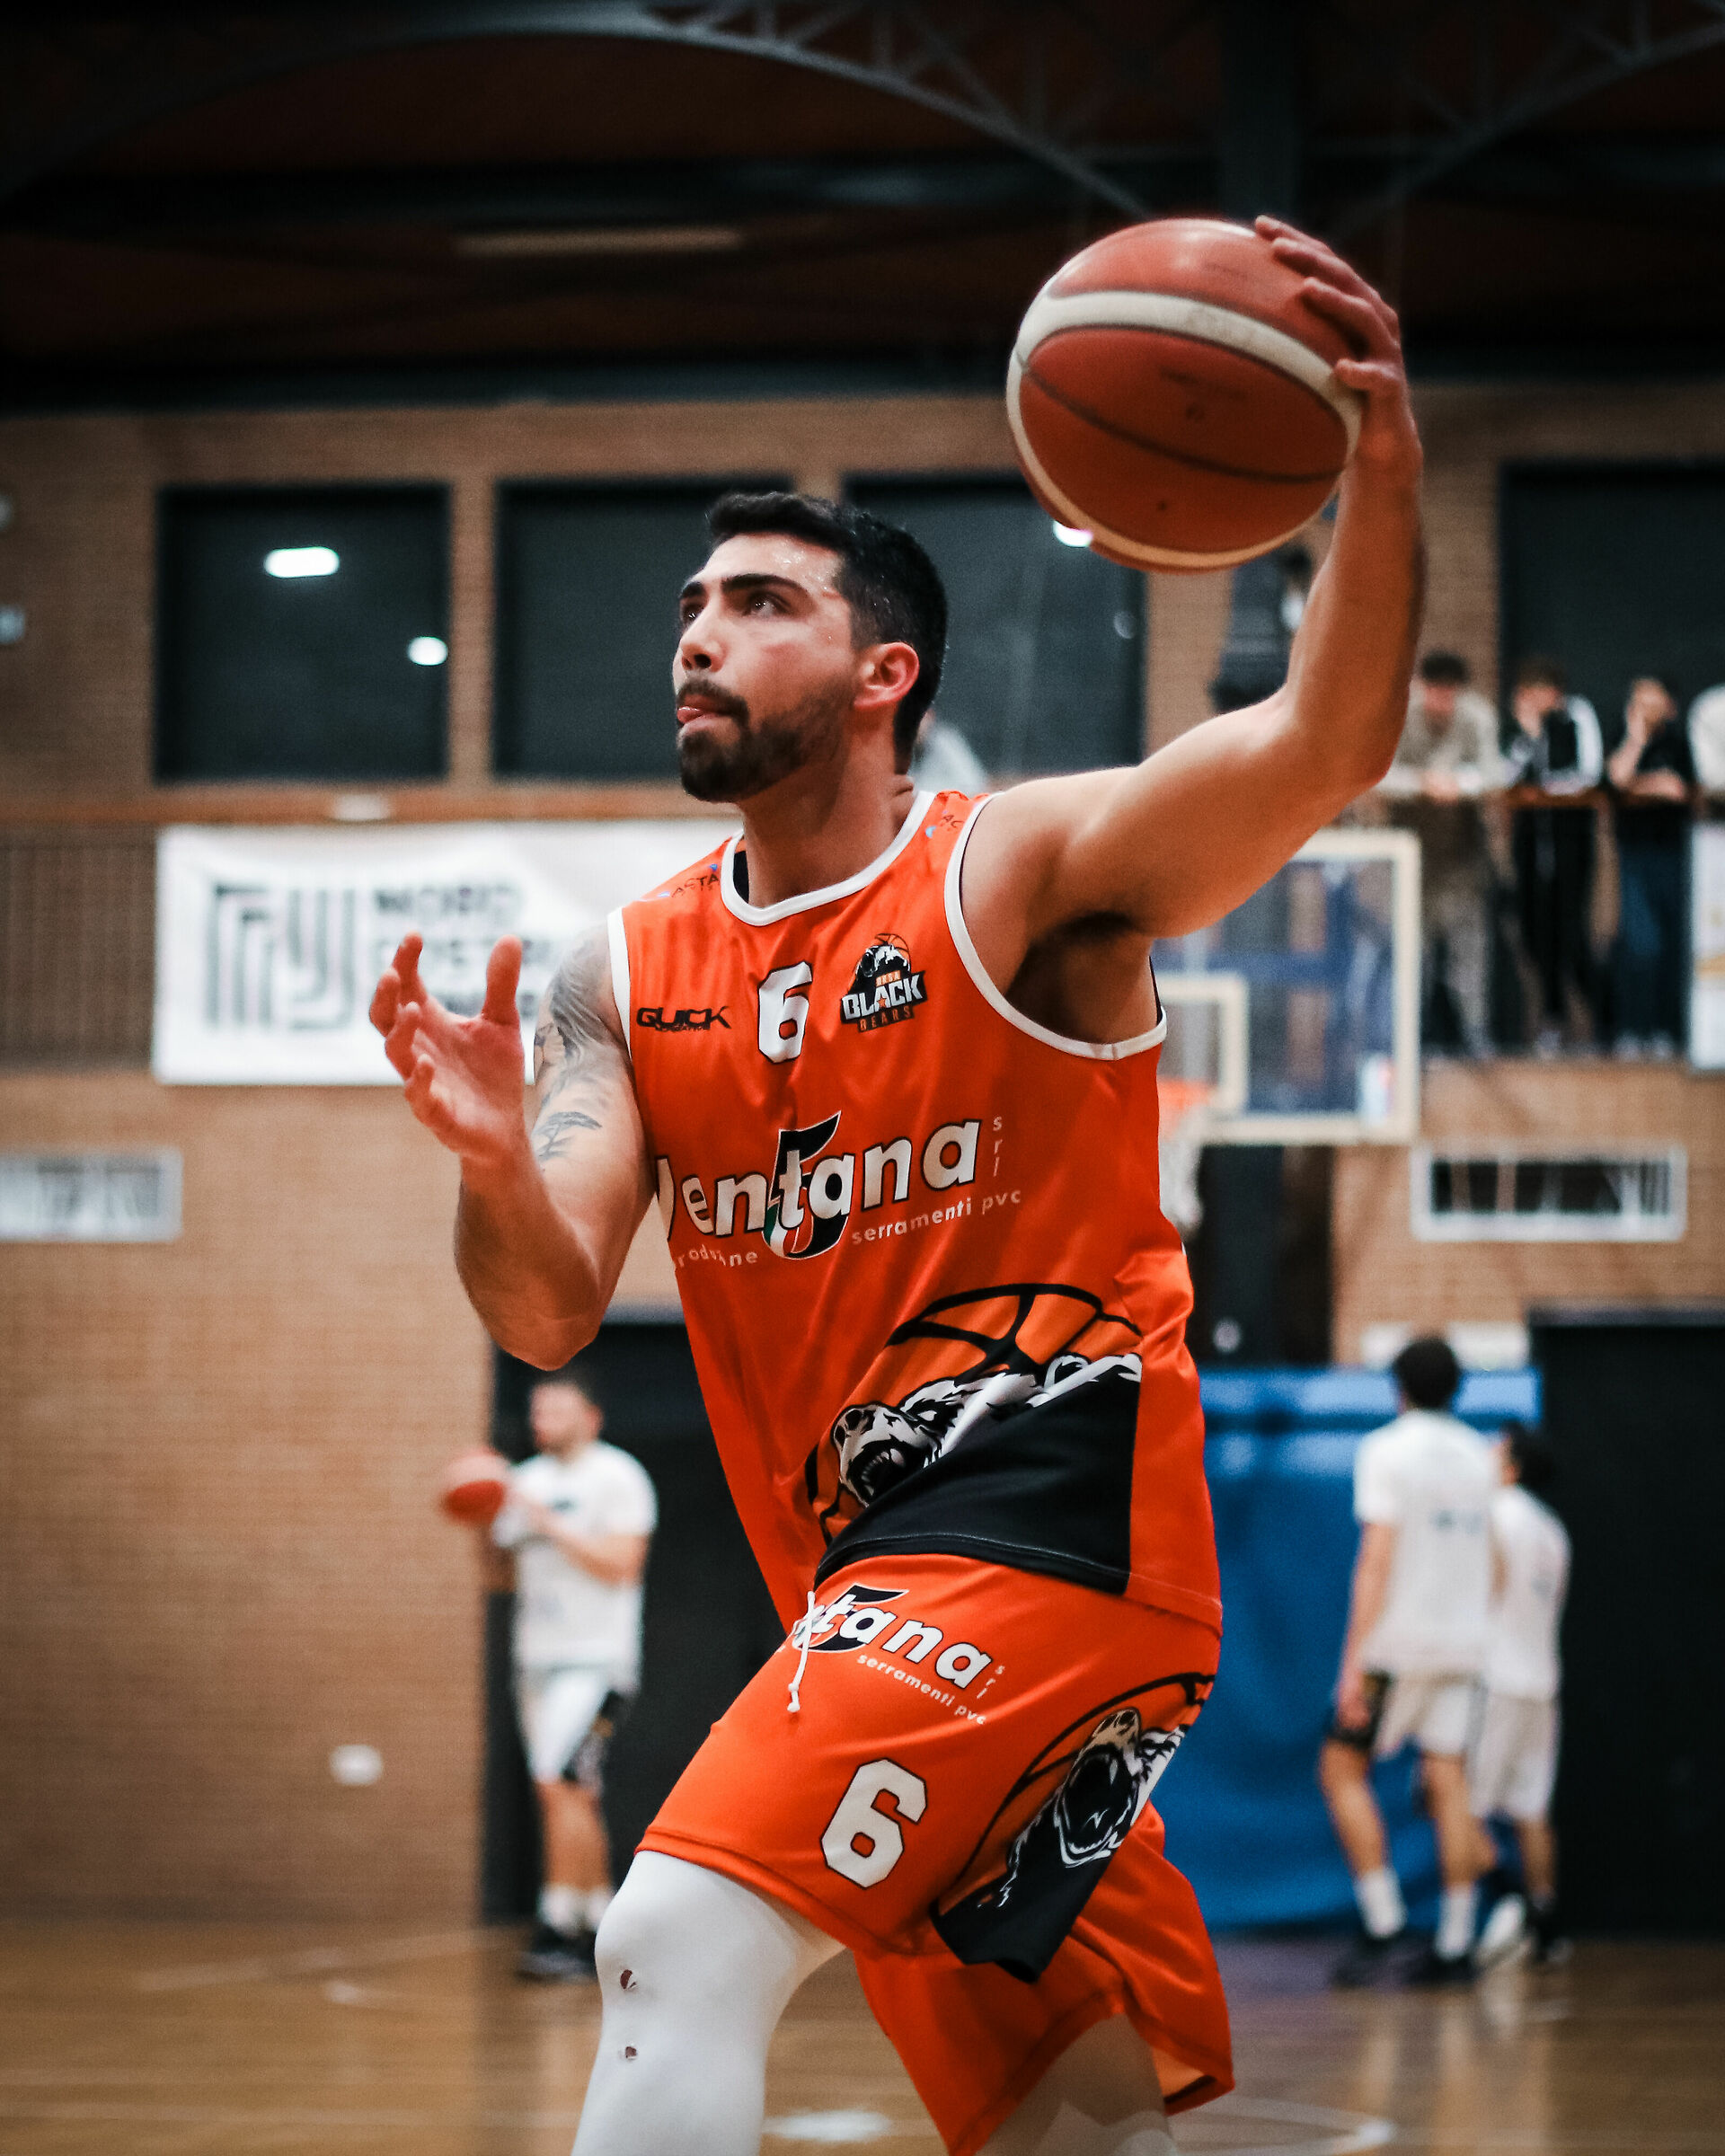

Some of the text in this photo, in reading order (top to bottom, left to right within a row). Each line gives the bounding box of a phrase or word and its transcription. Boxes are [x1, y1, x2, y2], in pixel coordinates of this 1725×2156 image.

[636, 1005, 732, 1030] QUICK
[757, 960, 813, 1065] 6
[841, 974, 923, 1021] BLACK
[859, 1005, 911, 1031] BEARS
[852, 1189, 1022, 1245] serramenti pvc
[856, 1653, 987, 1726] serramenti pvc
[821, 1758, 928, 1889] 6
